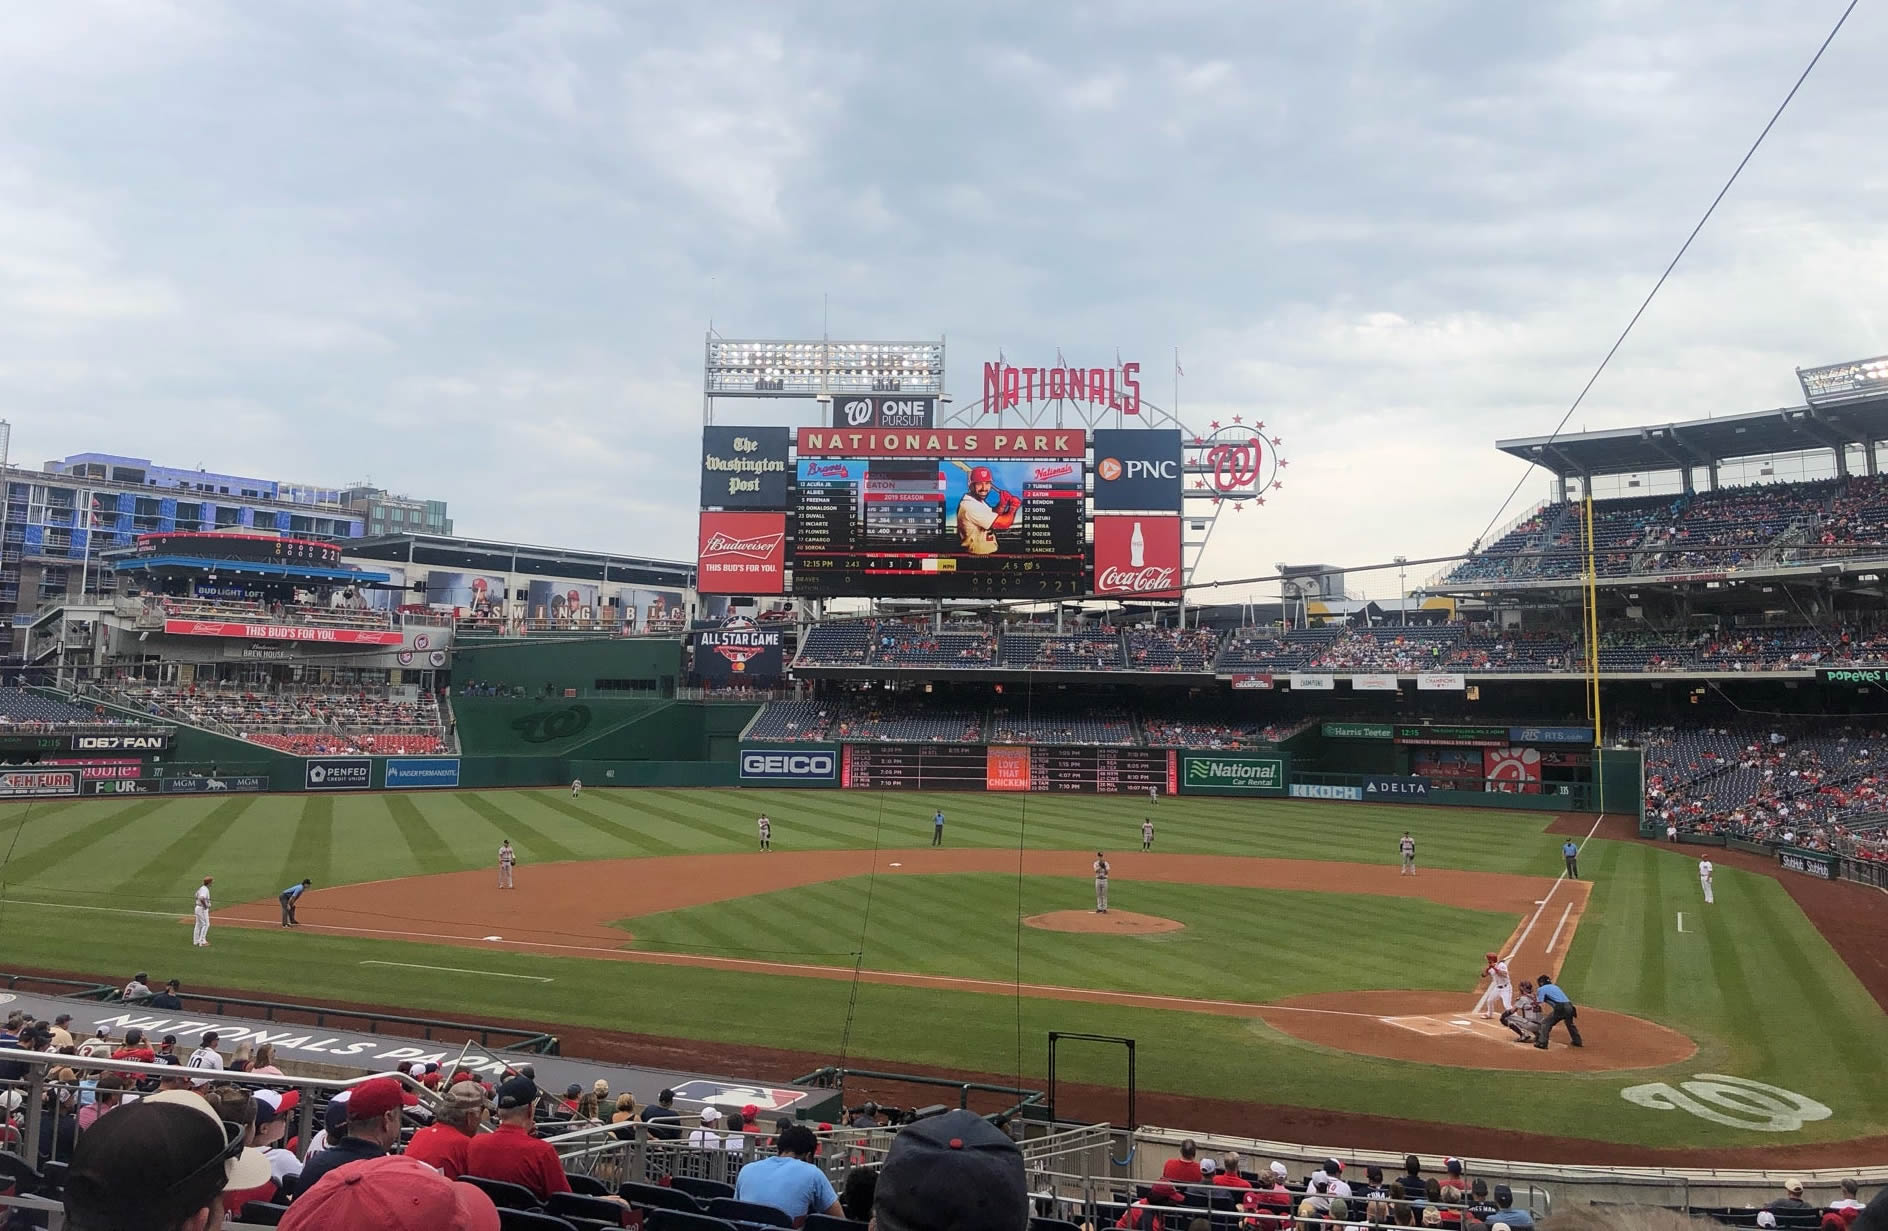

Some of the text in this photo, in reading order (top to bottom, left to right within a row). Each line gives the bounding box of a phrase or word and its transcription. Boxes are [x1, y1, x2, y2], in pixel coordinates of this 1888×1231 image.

[984, 362, 1140, 415] NATIONALS
[882, 401, 925, 416] ONE
[882, 416, 925, 427] PURSUIT
[733, 437, 759, 454] The
[808, 434, 1070, 451] NATIONALS PARK
[705, 454, 786, 474] Washington
[1125, 460, 1177, 479] PNC
[728, 477, 761, 496] Post
[707, 537, 776, 551] Budweiser
[322, 548, 328, 560] 2
[330, 550, 335, 560] 2
[706, 564, 777, 572] THIS BUD'S FOR YOU.
[803, 560, 821, 568] 12:15
[822, 560, 833, 568] PM
[1098, 565, 1177, 592] Coca-Cola
[198, 587, 265, 598] BUD LIGHT LOFT
[1040, 581, 1047, 591] 2
[1055, 581, 1062, 592] 2
[1071, 581, 1077, 592] 1
[245, 626, 337, 640] THIS BUD'S FOR YOU.
[701, 632, 779, 645] ALL STAR GAME
[243, 649, 284, 658] BREW HOUSE
[1335, 728, 1392, 737] Harris Teeter
[1545, 731, 1583, 740] RTS.com
[123, 738, 162, 748] FAN
[744, 756, 832, 774] GEICO
[998, 760, 1020, 769] LOVE
[1209, 763, 1276, 778] National
[153, 768, 163, 777] 377
[327, 768, 367, 776] PENFED
[998, 769, 1019, 778] THAT
[14, 775, 72, 788] F.H. FURR
[173, 780, 196, 788] MGM
[237, 778, 258, 786] MGM
[988, 778, 1028, 787] CHICKEN!
[1381, 782, 1426, 794] DELTA
[1560, 786, 1569, 795] 335
[1783, 855, 1829, 876] StubHub StubHub
[93, 1013, 533, 1075] NATIONALS PARK
[189, 1056, 203, 1068] 10
